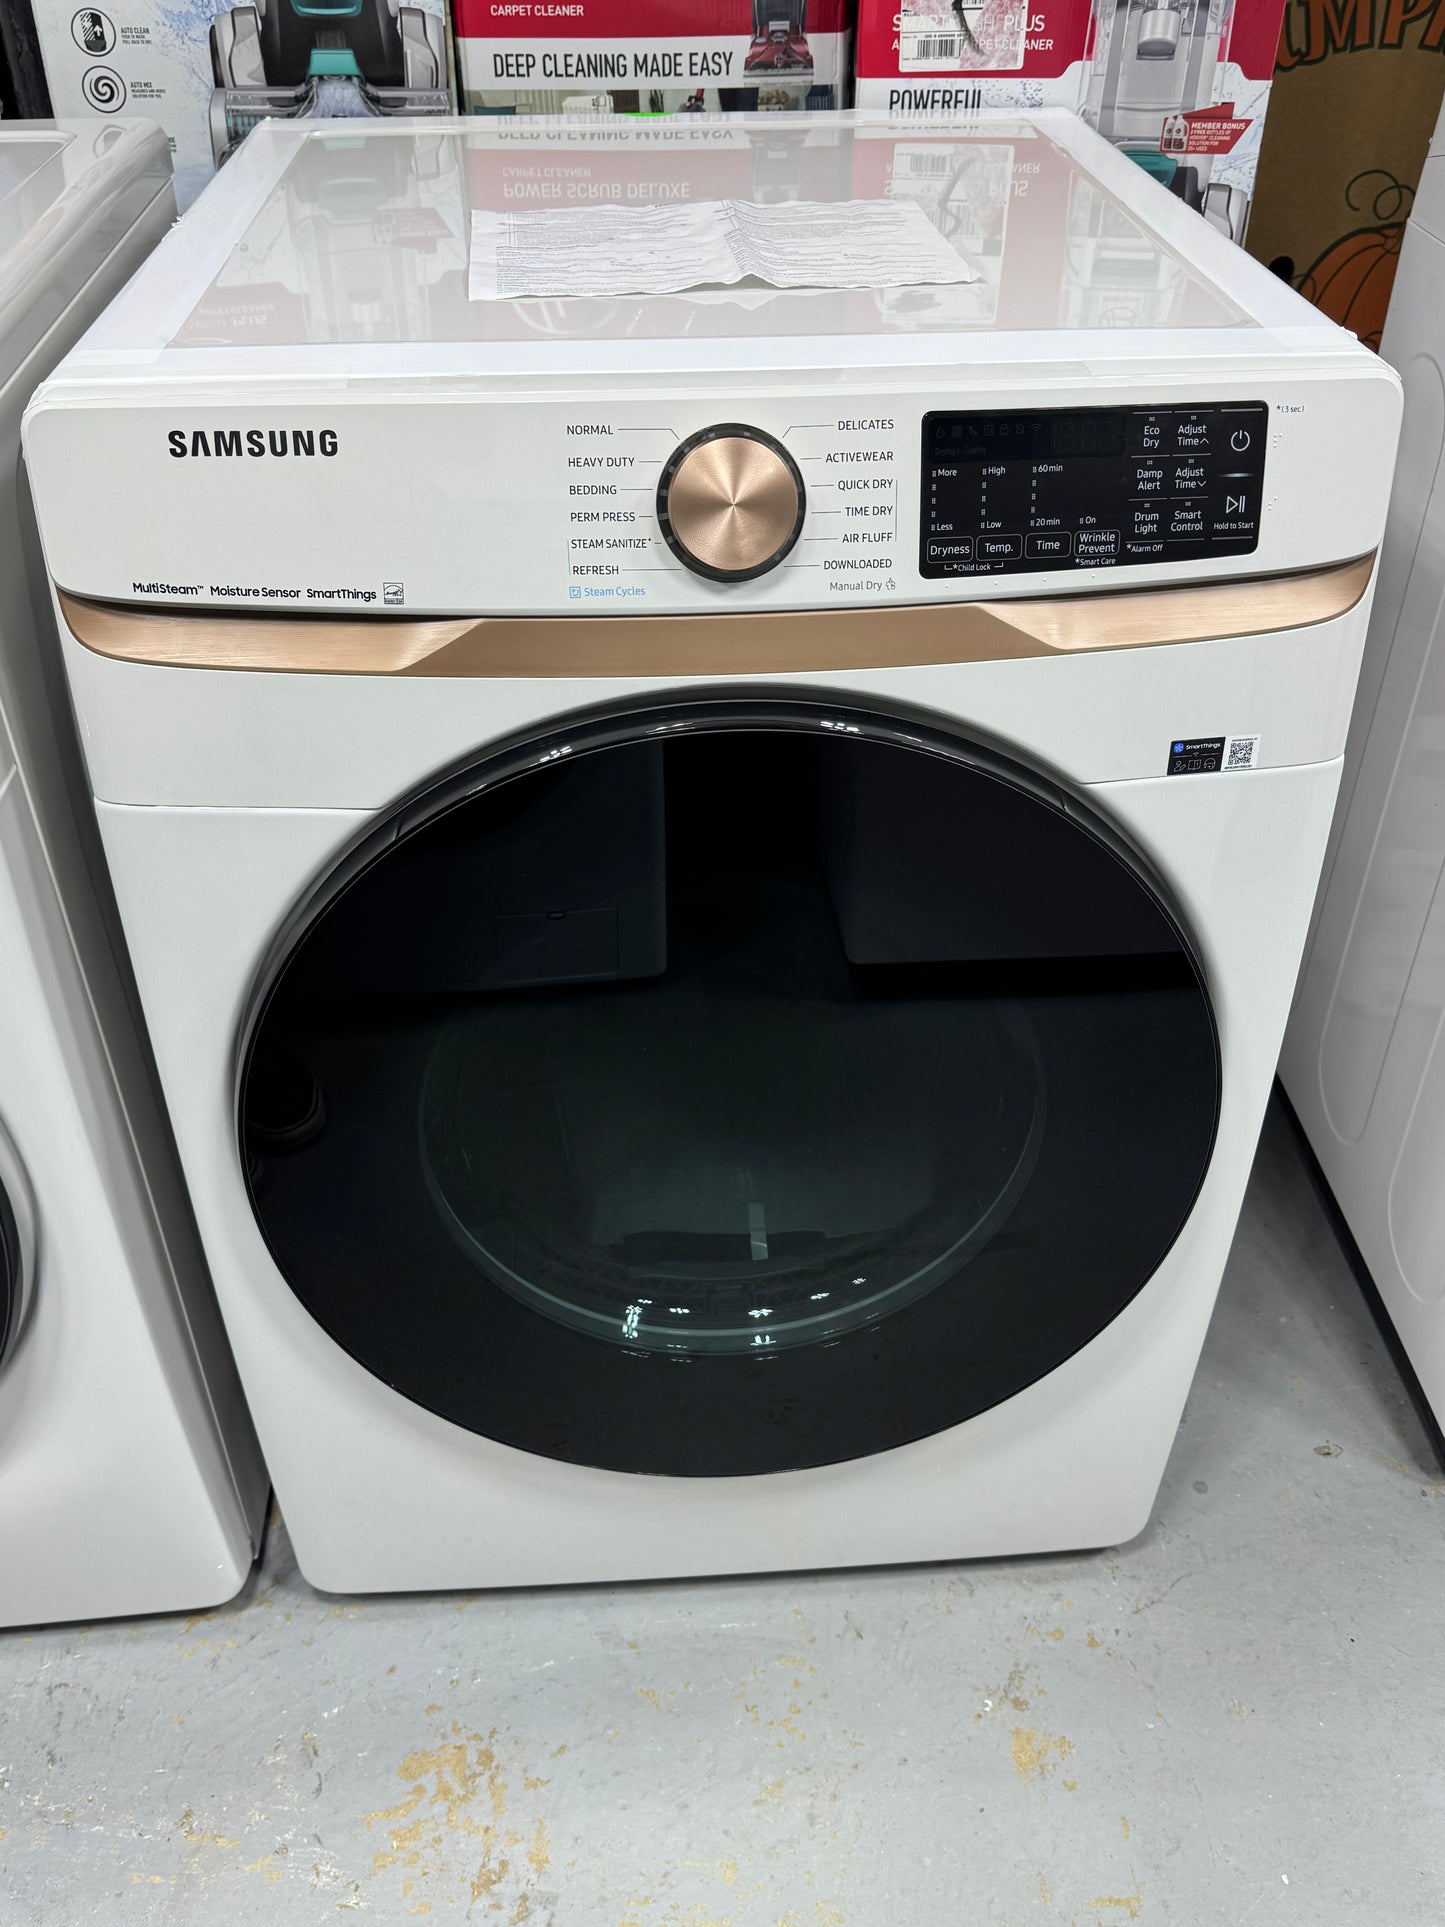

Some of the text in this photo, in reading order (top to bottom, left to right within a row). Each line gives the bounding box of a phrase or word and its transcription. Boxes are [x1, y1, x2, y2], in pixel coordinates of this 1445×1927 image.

[490, 4, 584, 17] CARPET CLEANER
[1004, 15, 1045, 32] PLUS
[493, 51, 733, 78] DEEP CLEANING MADE EASY
[567, 425, 613, 435] NORMAL
[838, 419, 894, 431] DELICATES
[1178, 424, 1207, 435] Adjust
[1144, 426, 1160, 435] Eco
[167, 429, 338, 458] SAMSUNG
[1143, 438, 1160, 449] Dry
[1177, 437, 1199, 446] Time
[568, 457, 634, 467] HEAVY DUTY
[826, 451, 894, 463] ACTIVEWEAR
[938, 469, 957, 477] More
[988, 466, 1006, 476] High
[1038, 464, 1063, 473] 60 min
[1175, 467, 1204, 478] Adjust
[1137, 469, 1163, 480] Damp
[838, 479, 893, 491] QUICK DRY
[1137, 481, 1160, 490] Alert
[1175, 479, 1196, 489] Time
[569, 485, 617, 495] BEDDING
[845, 506, 893, 516] TIME DRY
[1174, 510, 1201, 520] Smart
[570, 512, 636, 522] PERM PRESS
[1085, 516, 1096, 524] On
[1134, 512, 1159, 521] Drum
[937, 523, 953, 531] Less
[986, 521, 1001, 529] Low
[1036, 518, 1061, 527] 20 min
[1170, 521, 1203, 531] Control
[1213, 522, 1228, 530] Hold
[1135, 523, 1157, 535] Light
[842, 532, 893, 543] AIR FLUFF
[1079, 532, 1116, 542] Wrinkle
[571, 539, 603, 549] STEAM
[985, 543, 1014, 554] Temp.
[1036, 540, 1060, 550] Time
[1078, 544, 1115, 554] Prevent
[930, 545, 970, 557] Dryness
[824, 559, 892, 570] DOWNLOADED
[1101, 557, 1116, 565] Care
[573, 565, 619, 575] REFRESH
[830, 581, 882, 591] Manual Dry
[210, 585, 260, 598] Moisture
[262, 587, 301, 599] Sensor
[306, 588, 377, 602] SmartThings
[584, 586, 645, 597] Steam Cycles
